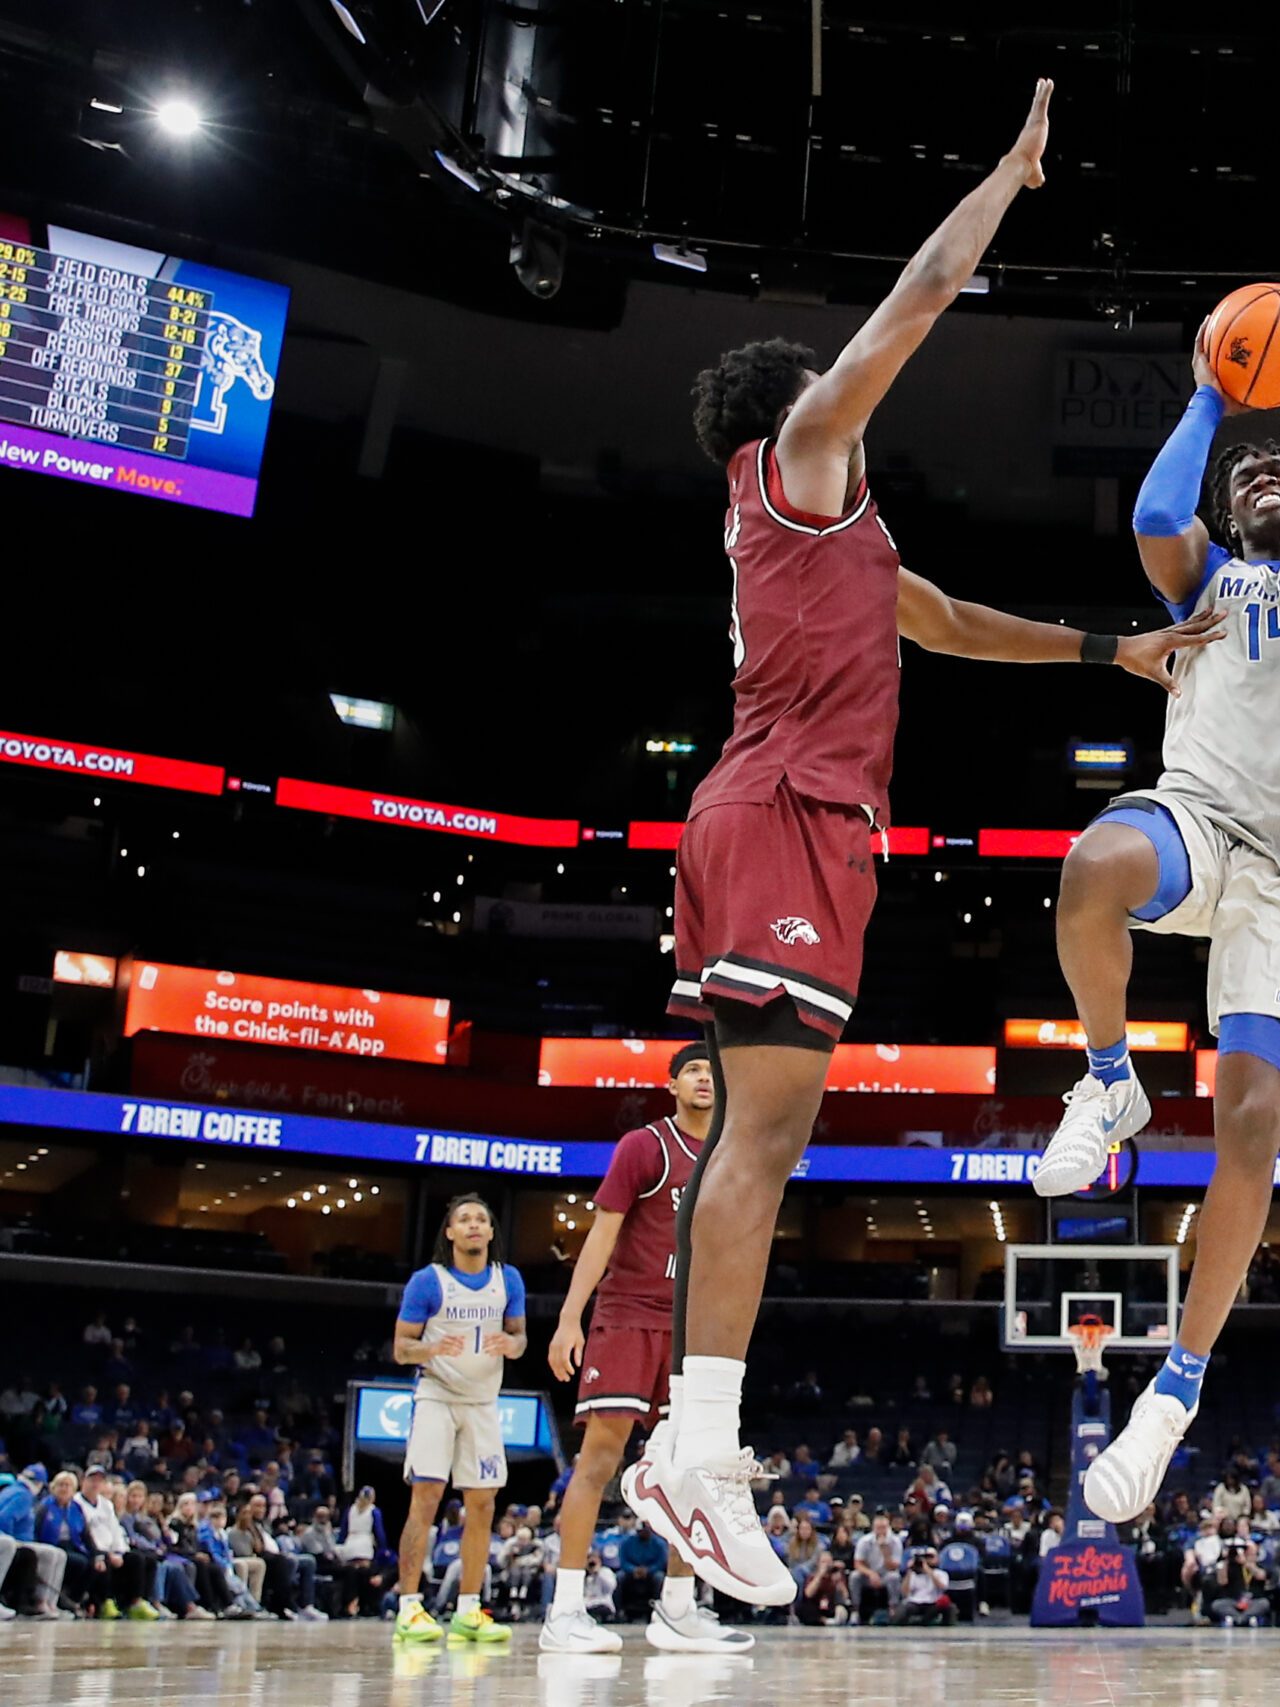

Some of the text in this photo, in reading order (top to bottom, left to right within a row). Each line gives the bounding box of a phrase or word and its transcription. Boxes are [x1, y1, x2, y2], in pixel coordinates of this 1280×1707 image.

[46, 273, 75, 297] 3-PT
[75, 281, 109, 305] FIELD
[109, 287, 150, 316] GOALS
[169, 306, 197, 325] 8-21
[55, 257, 96, 282] FIELD
[98, 267, 149, 296] GOALS
[168, 286, 205, 309] 44.4%
[48, 294, 196, 344] FREE THROWS 12-16
[60, 317, 122, 347] ASSISTS
[169, 344, 184, 361] 13
[31, 348, 175, 396] OFF REBOUNDS 9
[46, 333, 182, 378] REBOUNDS 37
[47, 391, 168, 432] BLOCKS 5
[52, 373, 172, 414] STEALS 9
[30, 405, 168, 451] TURNOVERS 12
[42, 449, 114, 480] Power
[116, 466, 182, 495] Move.
[372, 800, 496, 834] TOYOTA.COM
[205, 991, 375, 1029] Score points with
[194, 1015, 385, 1056] the Chick-fil-A App
[303, 1085, 404, 1117] FanDeck
[120, 1104, 282, 1146] 7 BREW COFFEE
[415, 1134, 563, 1174] 7 BREW COFFEE
[950, 1155, 966, 1180] 7
[967, 1155, 1025, 1181] BREW
[474, 1325, 481, 1354] 1
[1053, 1546, 1123, 1577] I Love
[1048, 1574, 1128, 1607] Memphis
